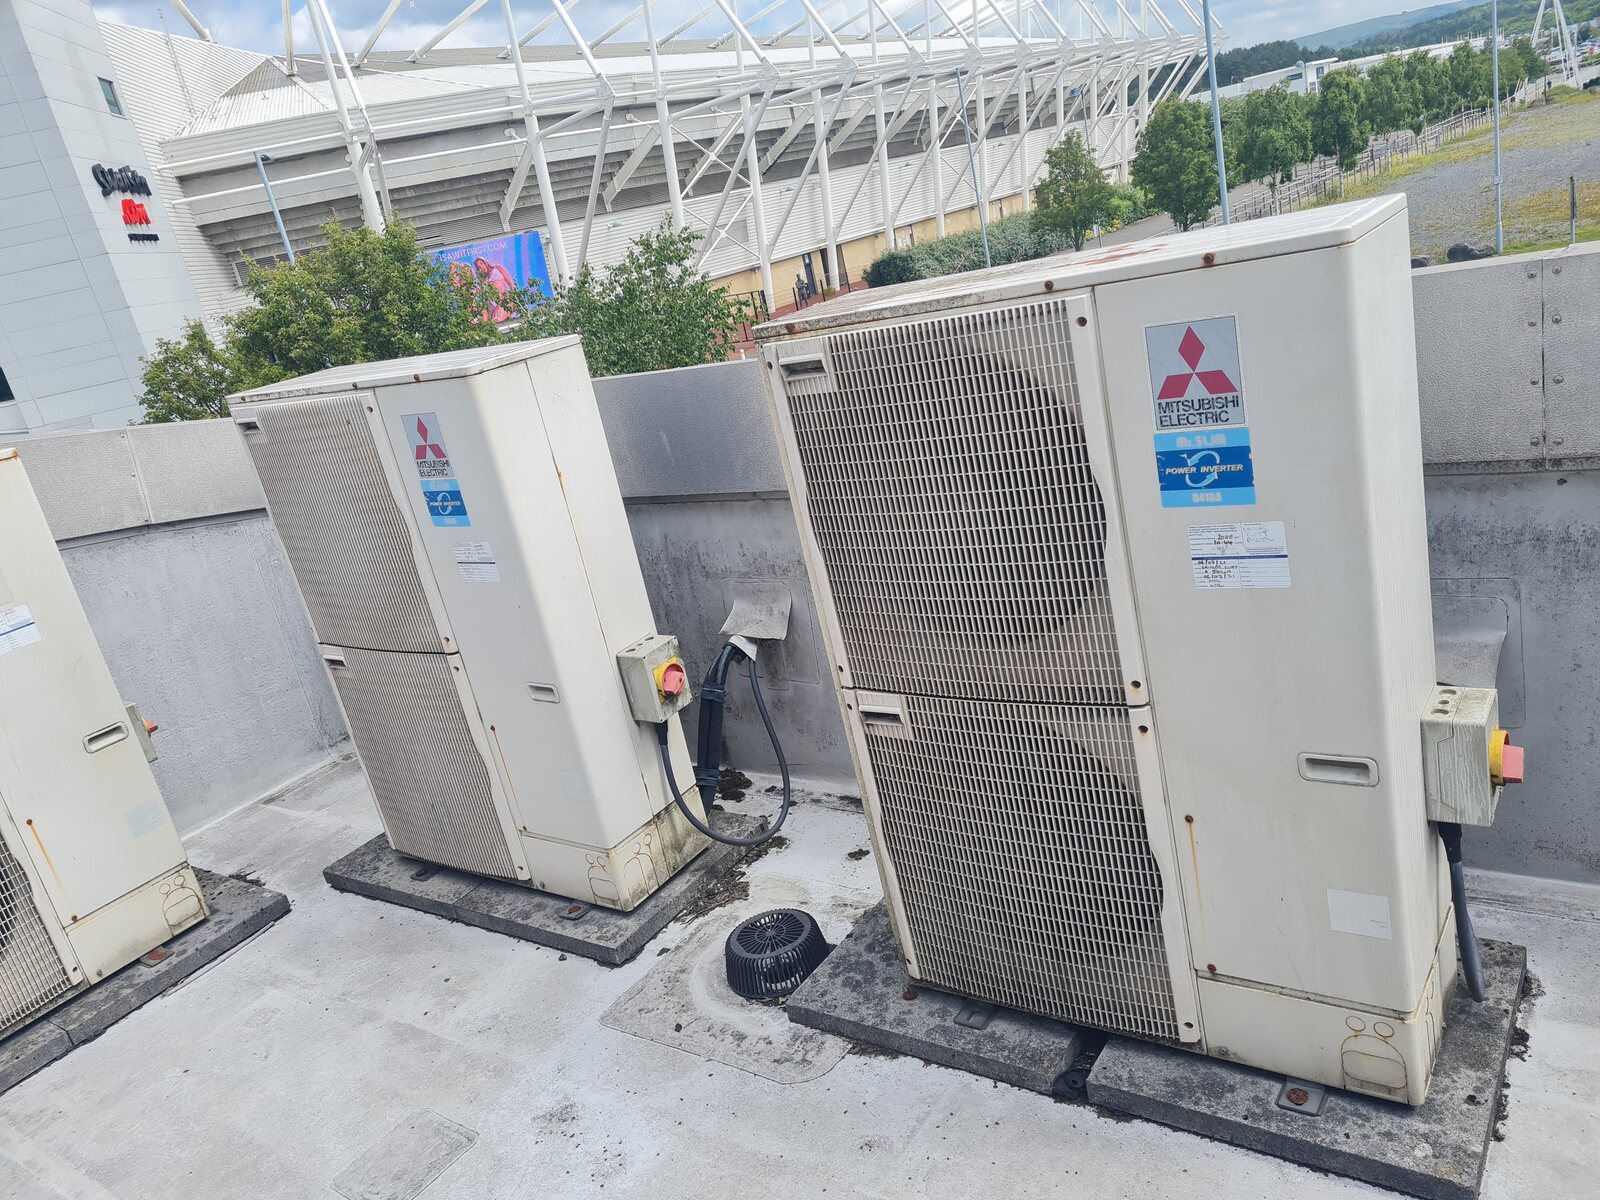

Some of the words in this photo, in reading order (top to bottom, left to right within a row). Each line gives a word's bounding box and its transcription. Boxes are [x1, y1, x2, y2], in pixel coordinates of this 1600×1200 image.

[1157, 395, 1240, 414] MITSUBISHI
[1159, 410, 1230, 427] ELECTRIC
[1165, 466, 1197, 475] POWER
[1200, 464, 1244, 473] INVERTER
